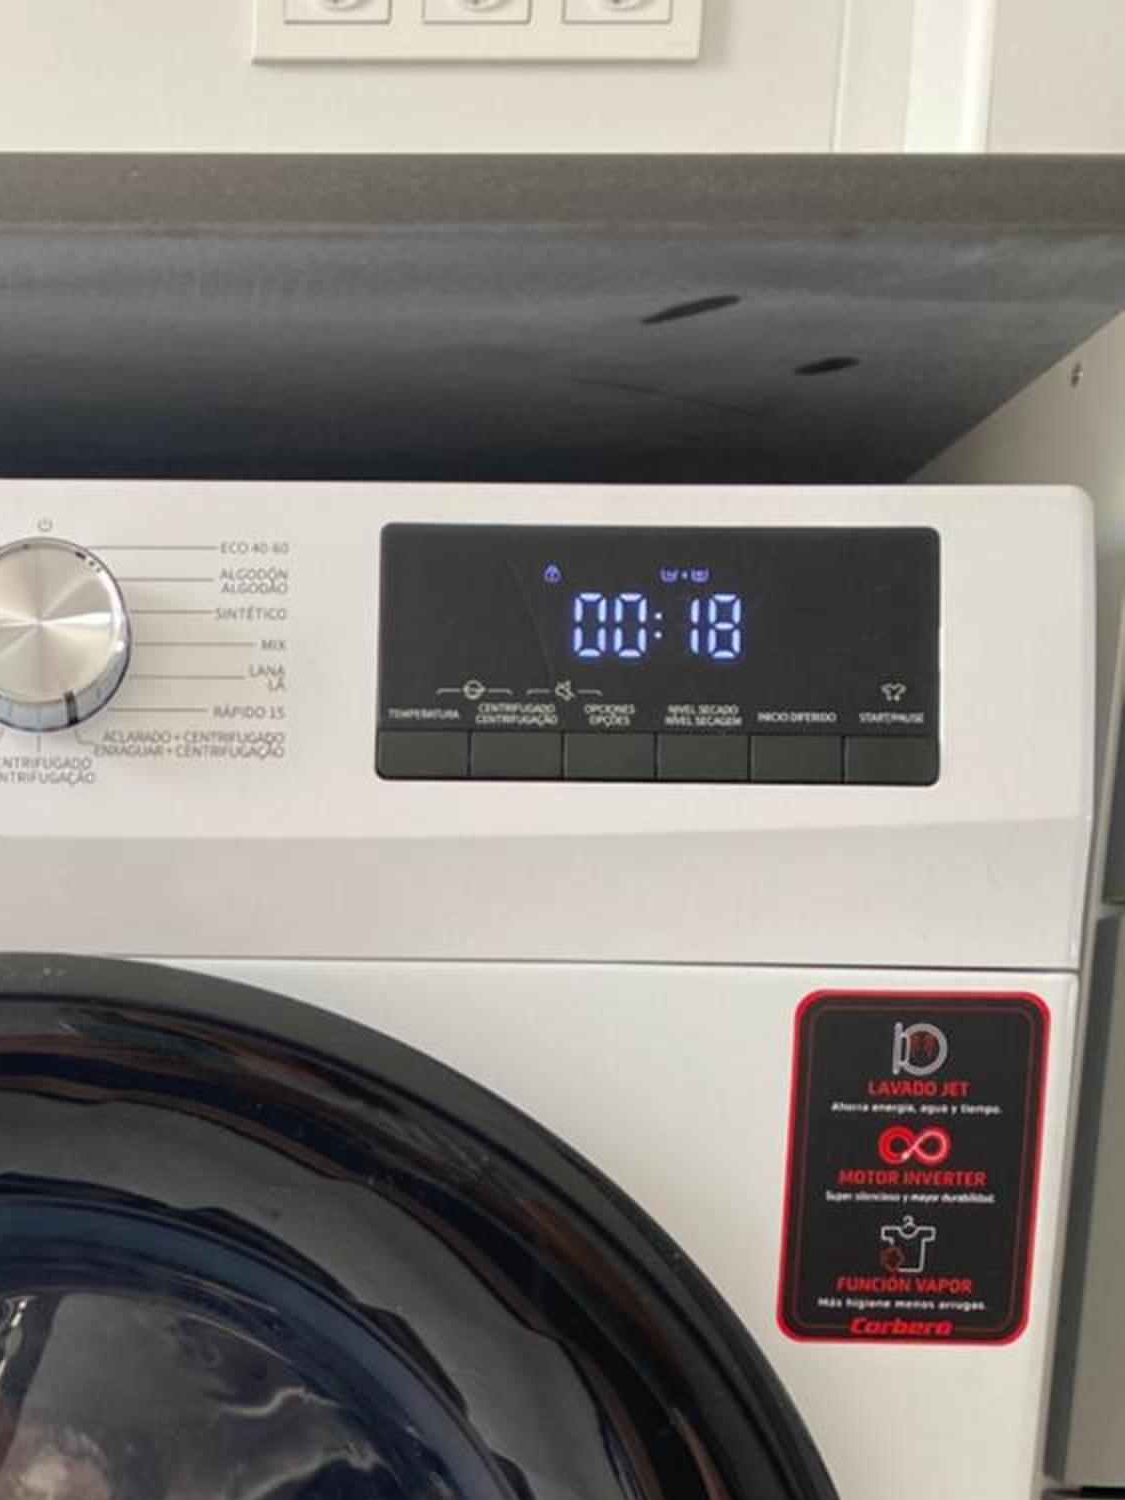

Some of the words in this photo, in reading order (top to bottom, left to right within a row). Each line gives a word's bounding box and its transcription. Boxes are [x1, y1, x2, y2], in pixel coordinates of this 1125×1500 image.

[220, 541, 249, 554] ECO
[220, 565, 288, 580] ALGODÓN
[215, 606, 287, 620] SINTÉTICO
[574, 591, 742, 660] 00:18
[260, 639, 286, 650] MIX
[249, 665, 285, 677] LANA
[270, 705, 286, 719] 15
[388, 708, 460, 720] TEMPERATURA
[478, 703, 556, 713] CENTRIFUGADO
[584, 704, 635, 715] OPCIONES
[698, 704, 739, 714] SECADO
[696, 716, 742, 727] SECAGEM
[757, 711, 788, 723] INICIO
[790, 711, 837, 723] DIFERIDO
[103, 731, 171, 744] ACLARADO
[183, 731, 285, 745] CENTRIFUGADO
[93, 745, 164, 758] ENXAGUAR
[868, 1080, 937, 1096] LAVADO
[941, 1081, 970, 1096] JET
[831, 1102, 868, 1112] Ahorra
[920, 1105, 948, 1115] agua
[839, 1170, 898, 1185] MOTOR
[903, 1171, 987, 1186] INVERTER
[837, 1275, 910, 1292] FUNCIÓN
[916, 1279, 972, 1294] VAPOR
[895, 1300, 935, 1309] menos
